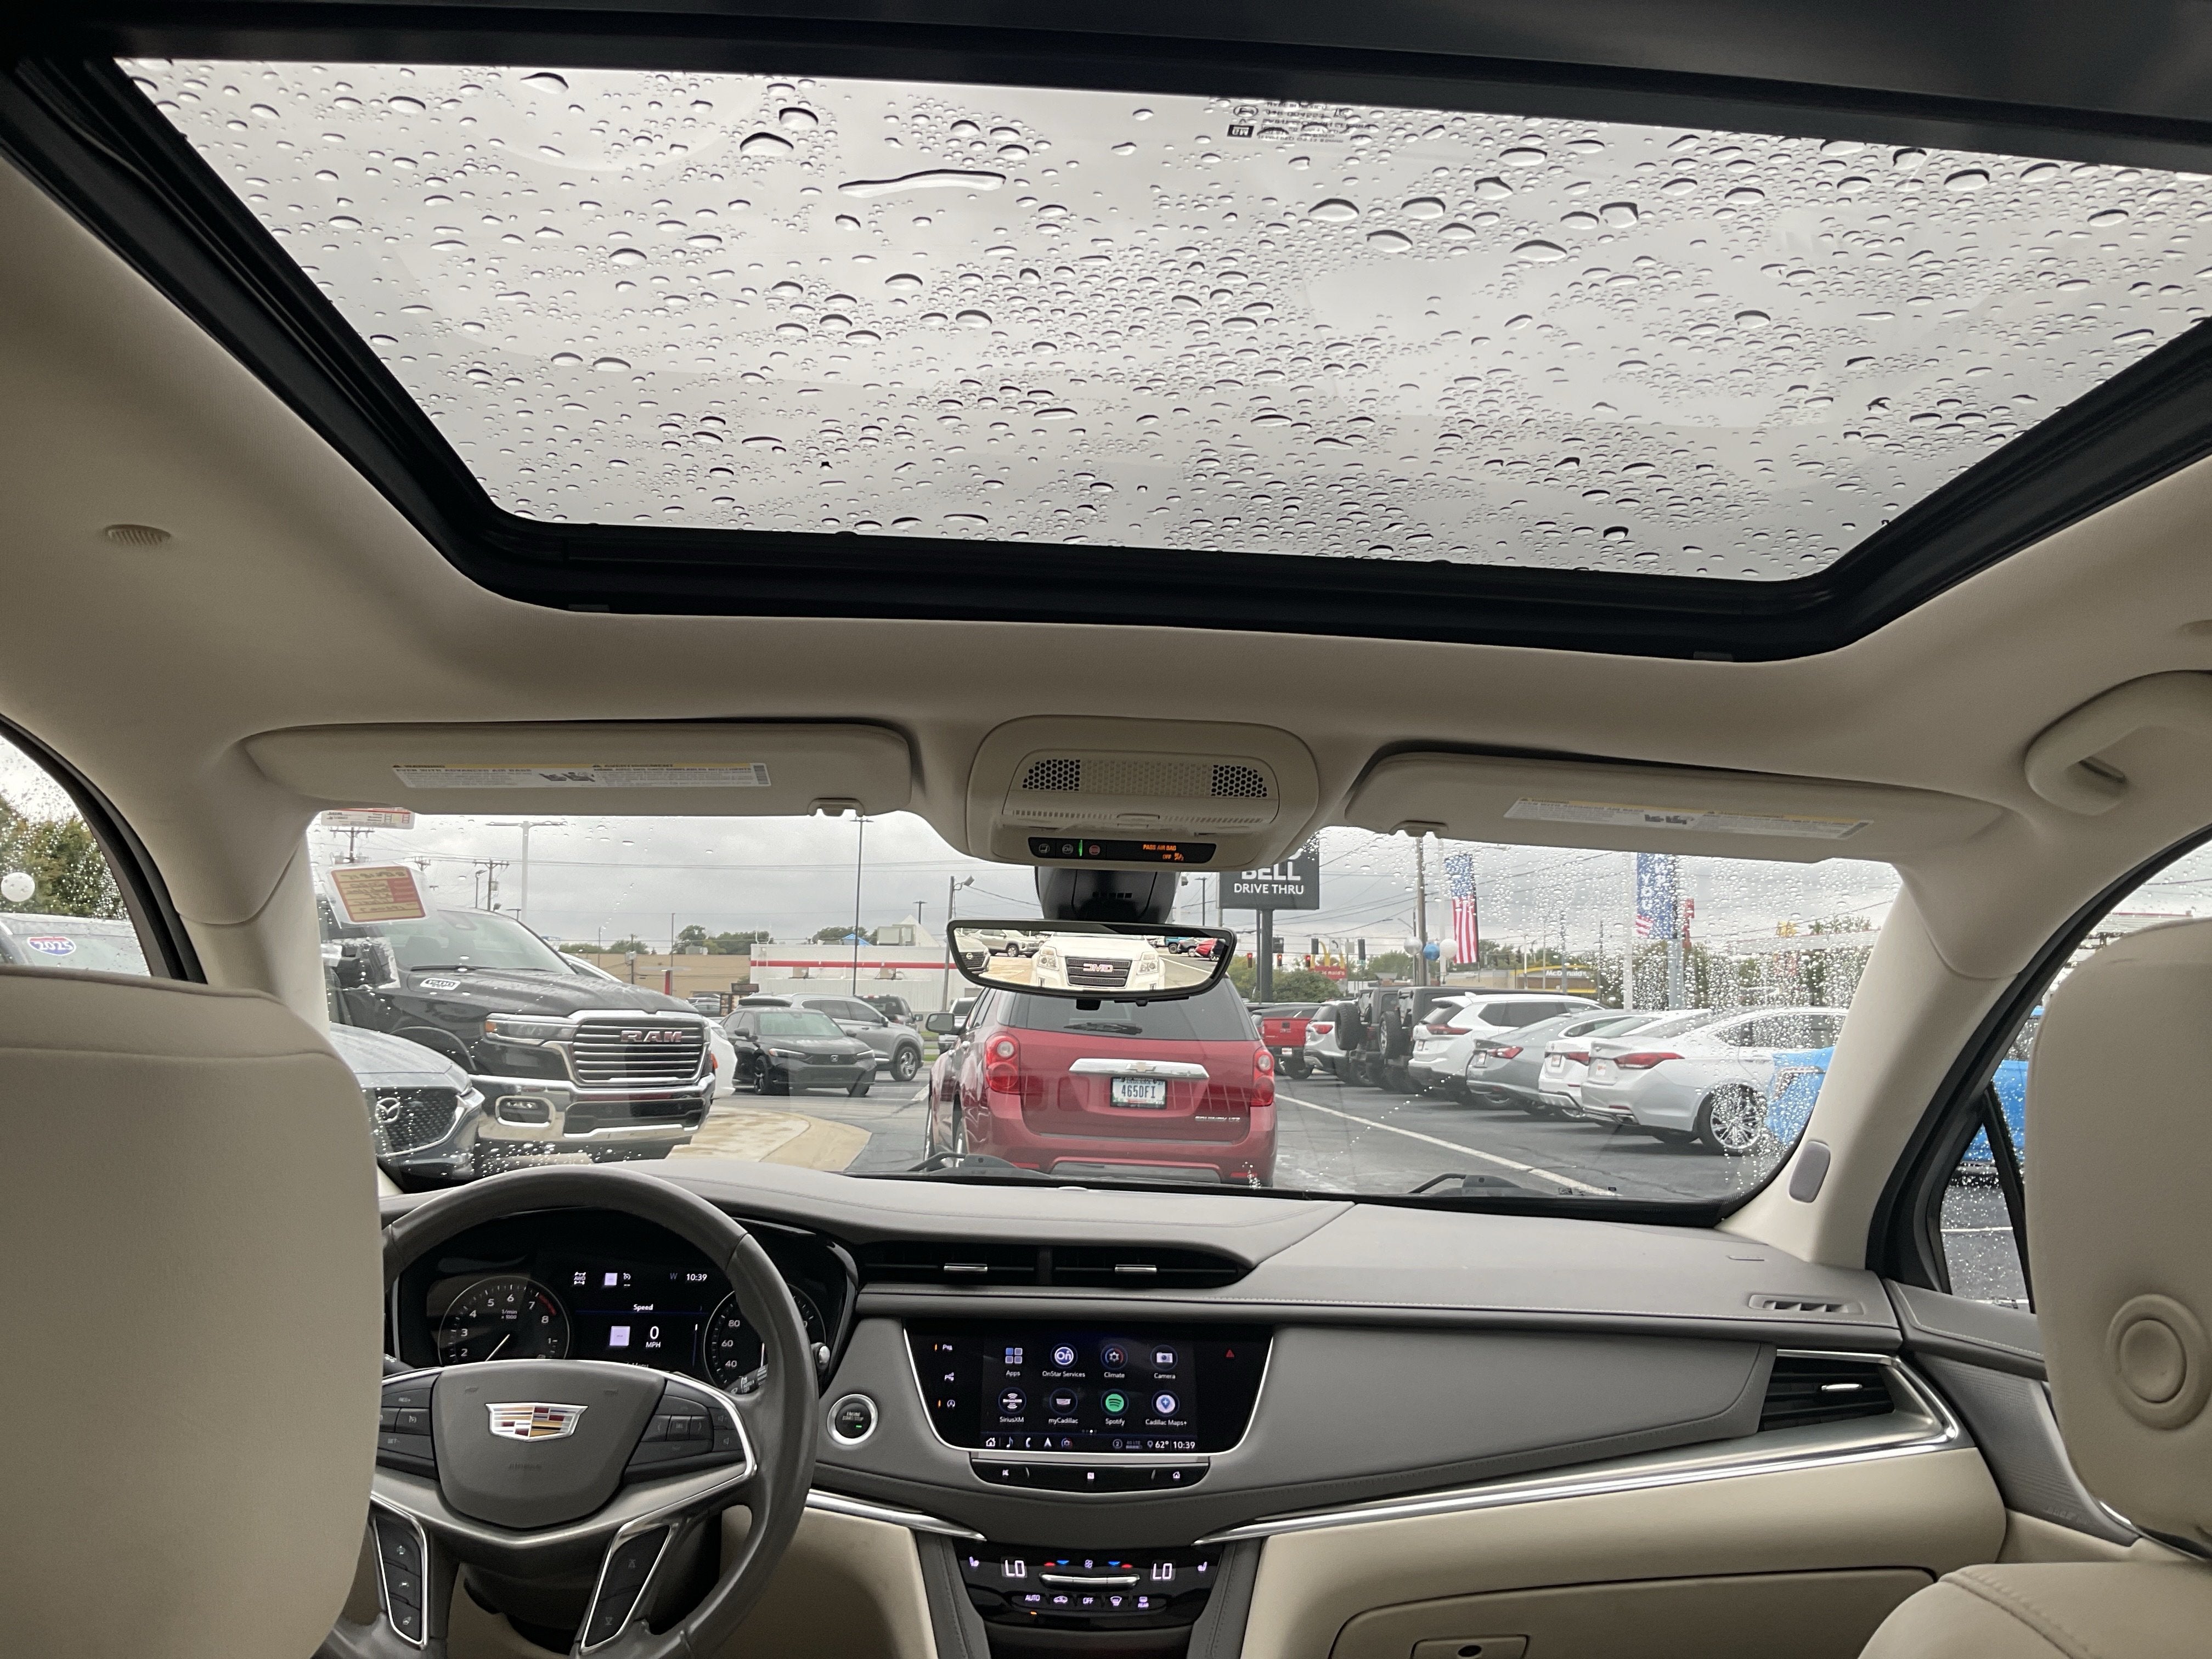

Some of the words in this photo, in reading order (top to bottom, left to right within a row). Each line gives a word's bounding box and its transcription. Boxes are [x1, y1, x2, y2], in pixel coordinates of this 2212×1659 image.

[1234, 883, 1268, 894] DRIVE
[1272, 884, 1304, 895] THRU
[34, 941, 74, 950] 2025
[620, 1030, 682, 1042] RAM
[487, 1298, 494, 1307] 5
[507, 1294, 515, 1302] 6
[528, 1301, 535, 1310] 7
[633, 1304, 654, 1312] Speed
[469, 1310, 477, 1318] 4
[541, 1315, 549, 1323] 8
[460, 1328, 468, 1337] 3
[650, 1325, 659, 1339] 0
[460, 1348, 468, 1357] 2
[1006, 1369, 1020, 1378] Apps
[1155, 1441, 1169, 1449] 62°
[1173, 1441, 1195, 1449] 10:39
[1005, 1559, 1025, 1577] LO
[1153, 1562, 1172, 1580] LO
